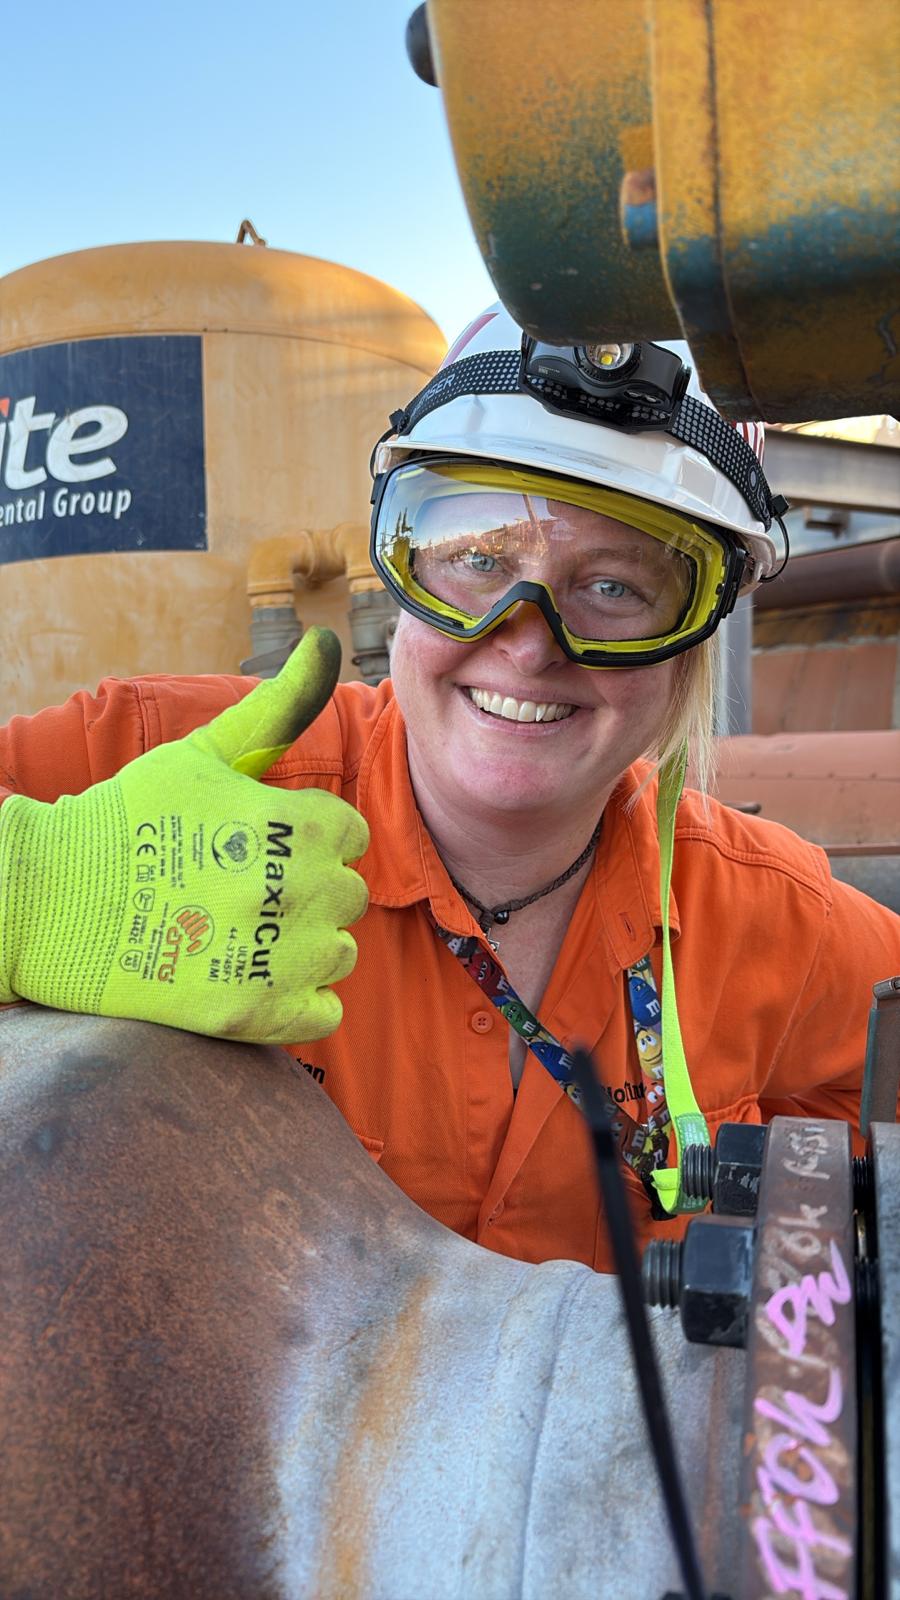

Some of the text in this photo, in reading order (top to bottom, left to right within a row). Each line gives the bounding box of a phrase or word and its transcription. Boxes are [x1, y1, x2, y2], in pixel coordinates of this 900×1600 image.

[0, 396, 128, 490] te
[53, 487, 131, 520] Group
[248, 821, 294, 981] MaxiCut
